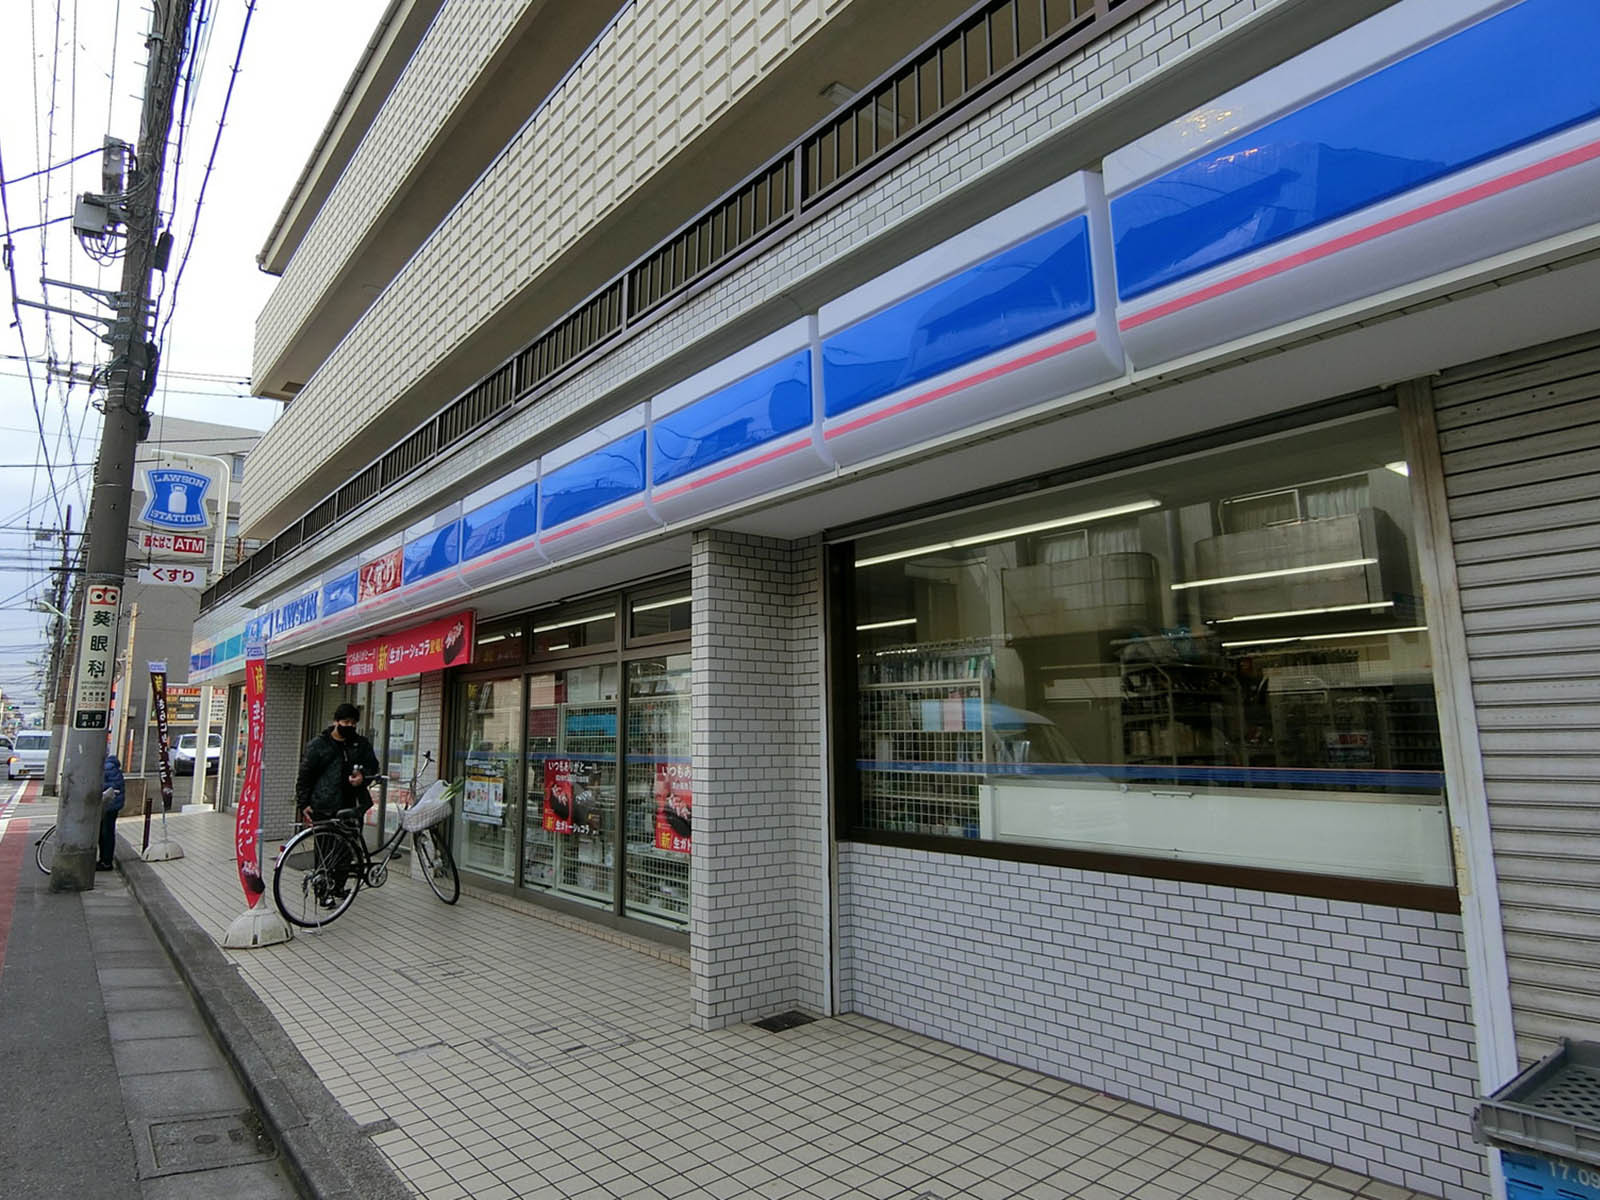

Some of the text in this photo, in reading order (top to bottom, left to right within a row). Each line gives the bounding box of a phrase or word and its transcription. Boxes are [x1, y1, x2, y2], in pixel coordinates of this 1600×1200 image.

[153, 474, 205, 488] LAWSON
[150, 509, 202, 523] STATION
[175, 538, 203, 552] ATM
[152, 568, 195, 583] くすり
[366, 559, 395, 593] くすり
[87, 610, 111, 677] 葵眼科
[660, 832, 671, 849] 新
